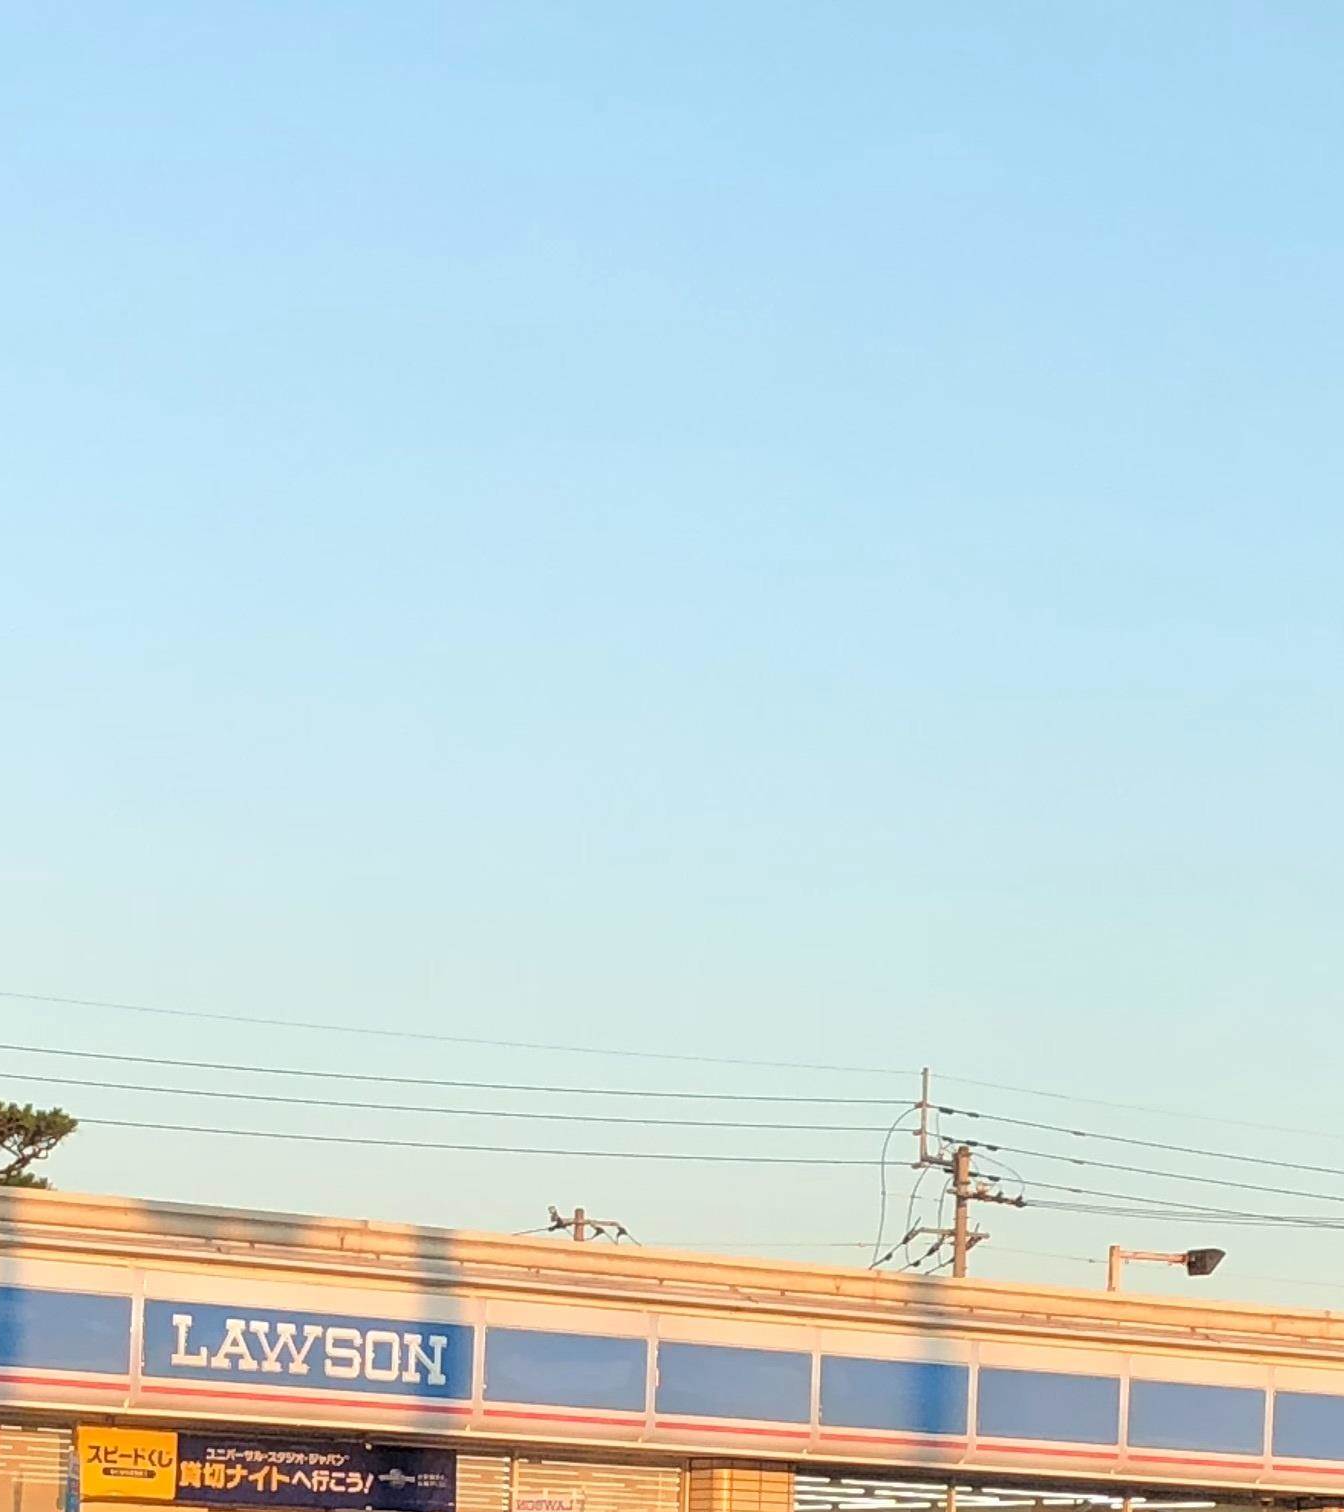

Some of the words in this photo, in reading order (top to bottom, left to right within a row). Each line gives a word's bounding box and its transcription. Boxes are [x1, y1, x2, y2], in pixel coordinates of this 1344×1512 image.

[171, 1313, 447, 1386] LAWSON
[87, 1445, 173, 1468] スピードくじ
